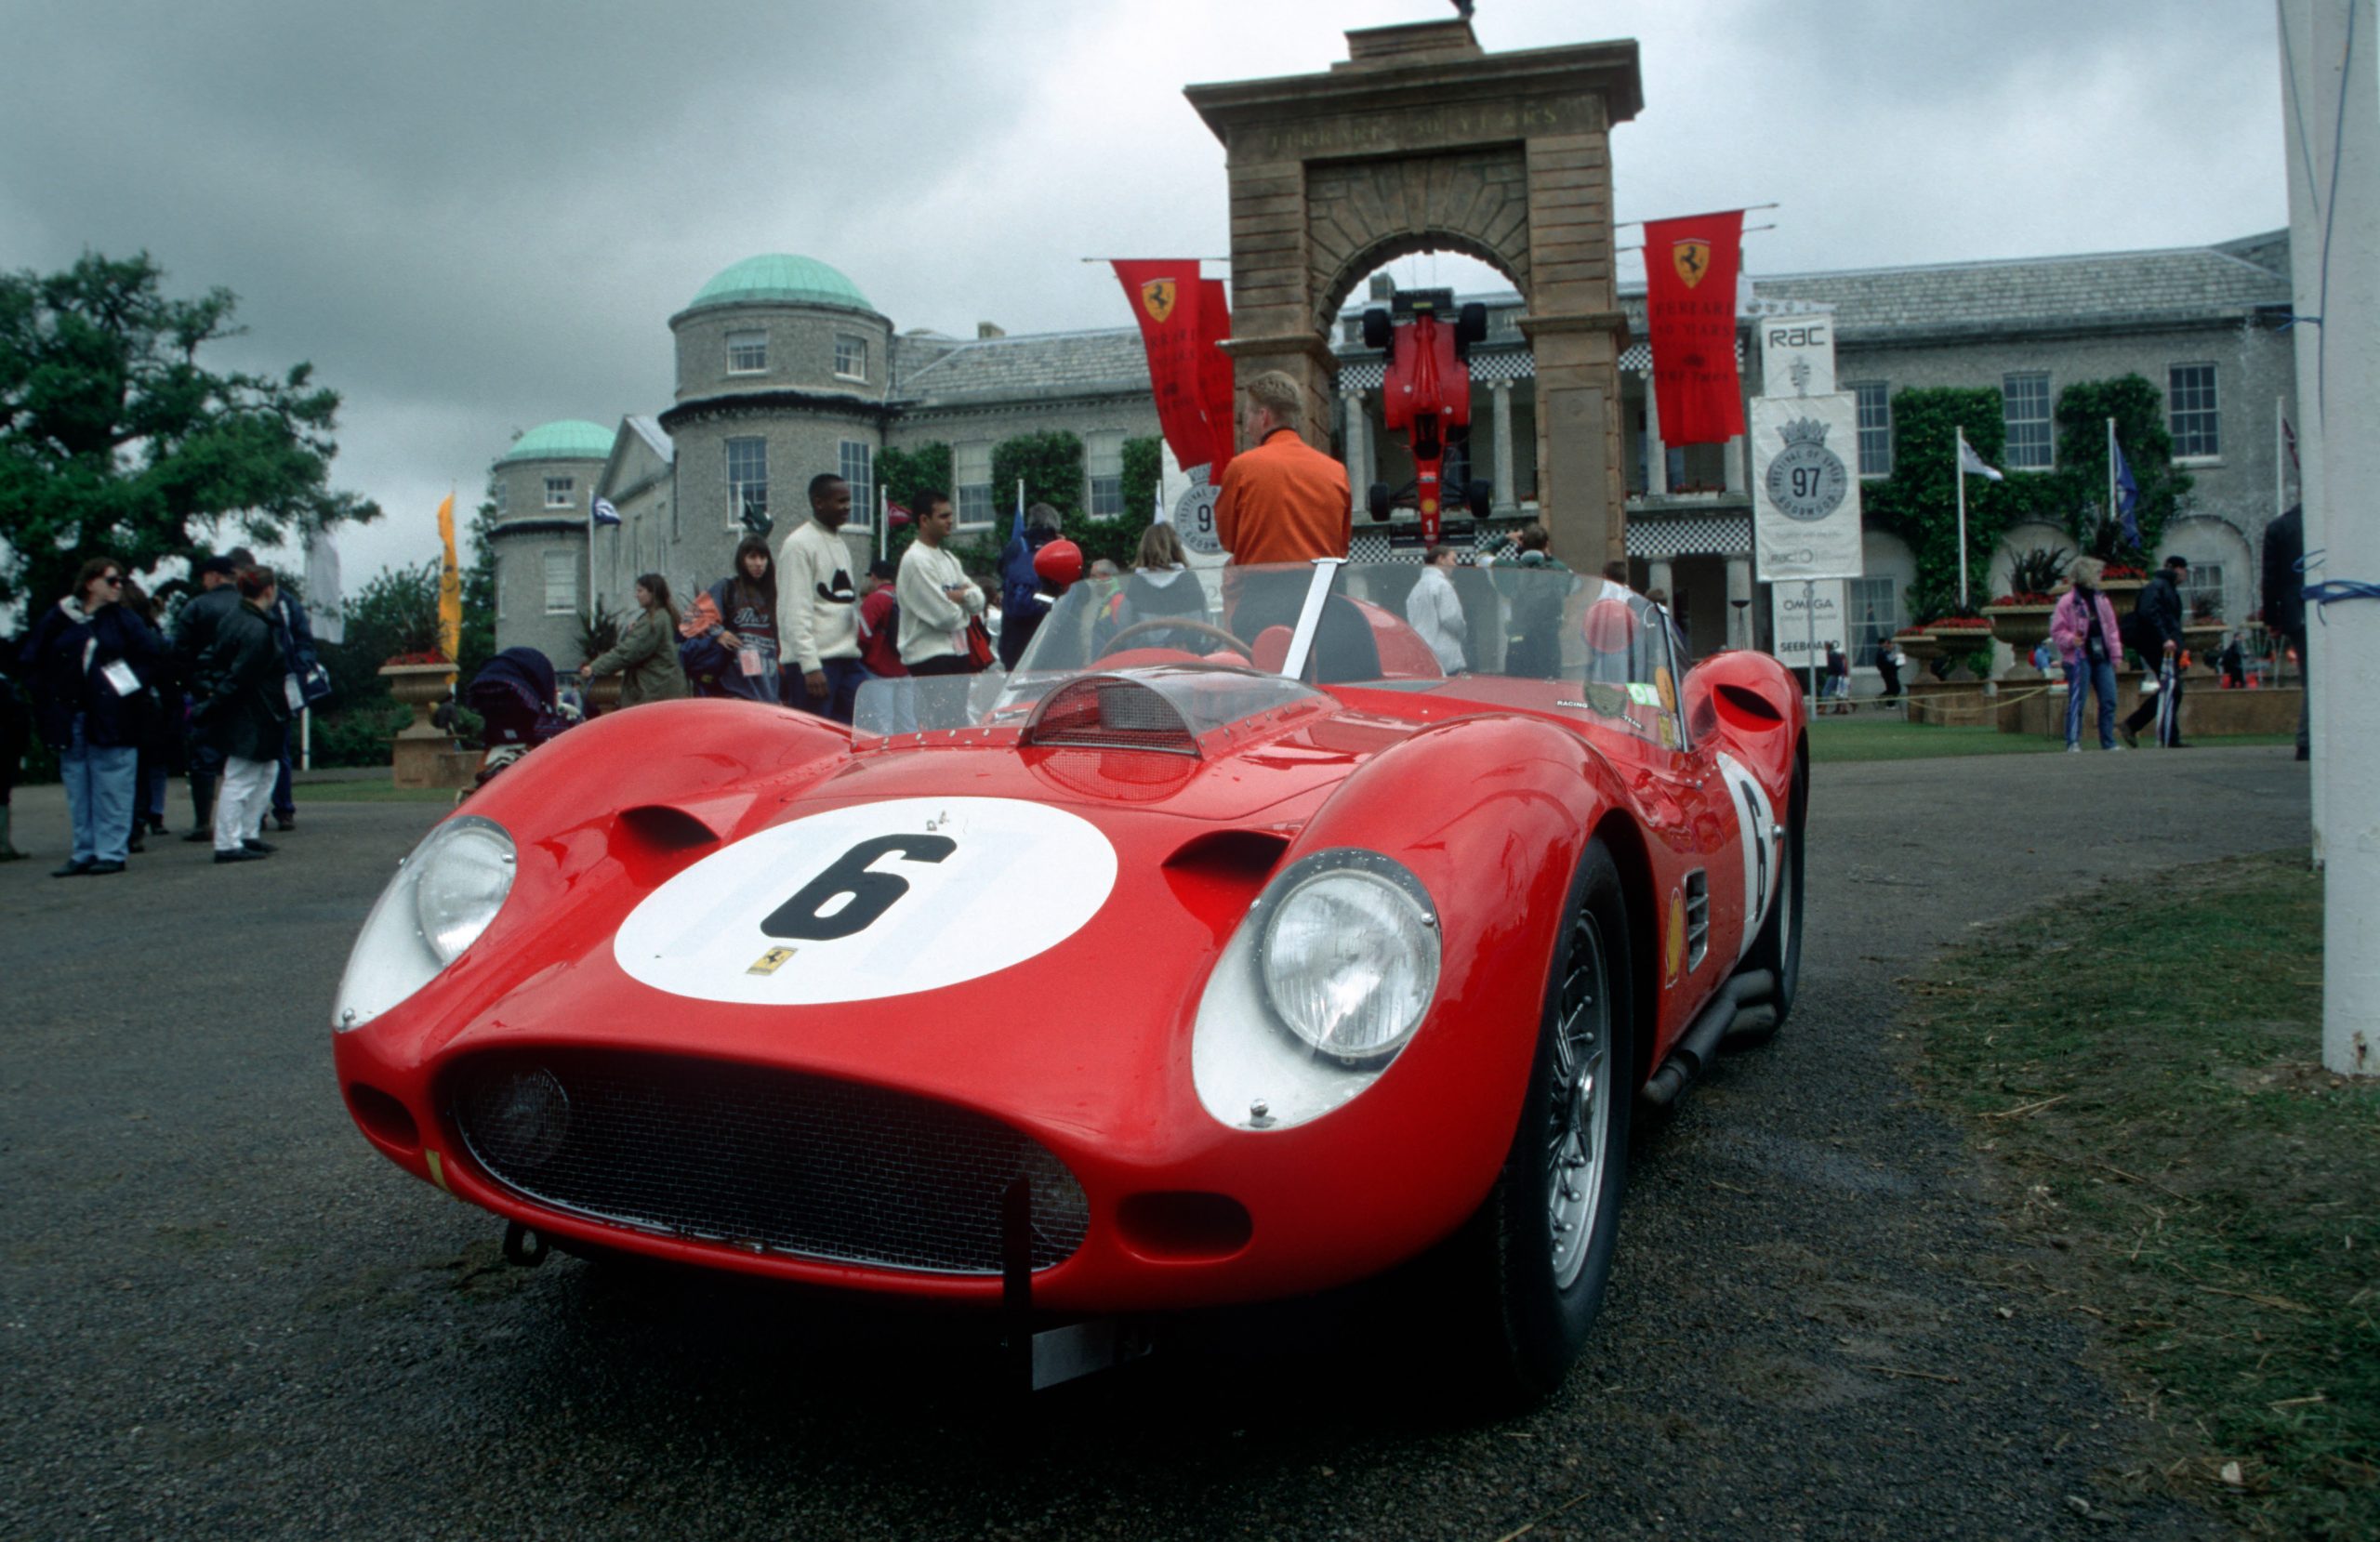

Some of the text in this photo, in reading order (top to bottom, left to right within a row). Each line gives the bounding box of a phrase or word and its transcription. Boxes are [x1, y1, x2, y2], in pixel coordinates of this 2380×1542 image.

[1655, 300, 1732, 318] FERRARI
[1792, 468, 1821, 498] 97
[1778, 494, 1837, 516] GOODWOOD
[1198, 504, 1211, 534] 9
[1426, 519, 1434, 533] 1
[1556, 700, 1589, 709] RACING
[1740, 780, 1765, 923] 6
[760, 833, 958, 942] 6
